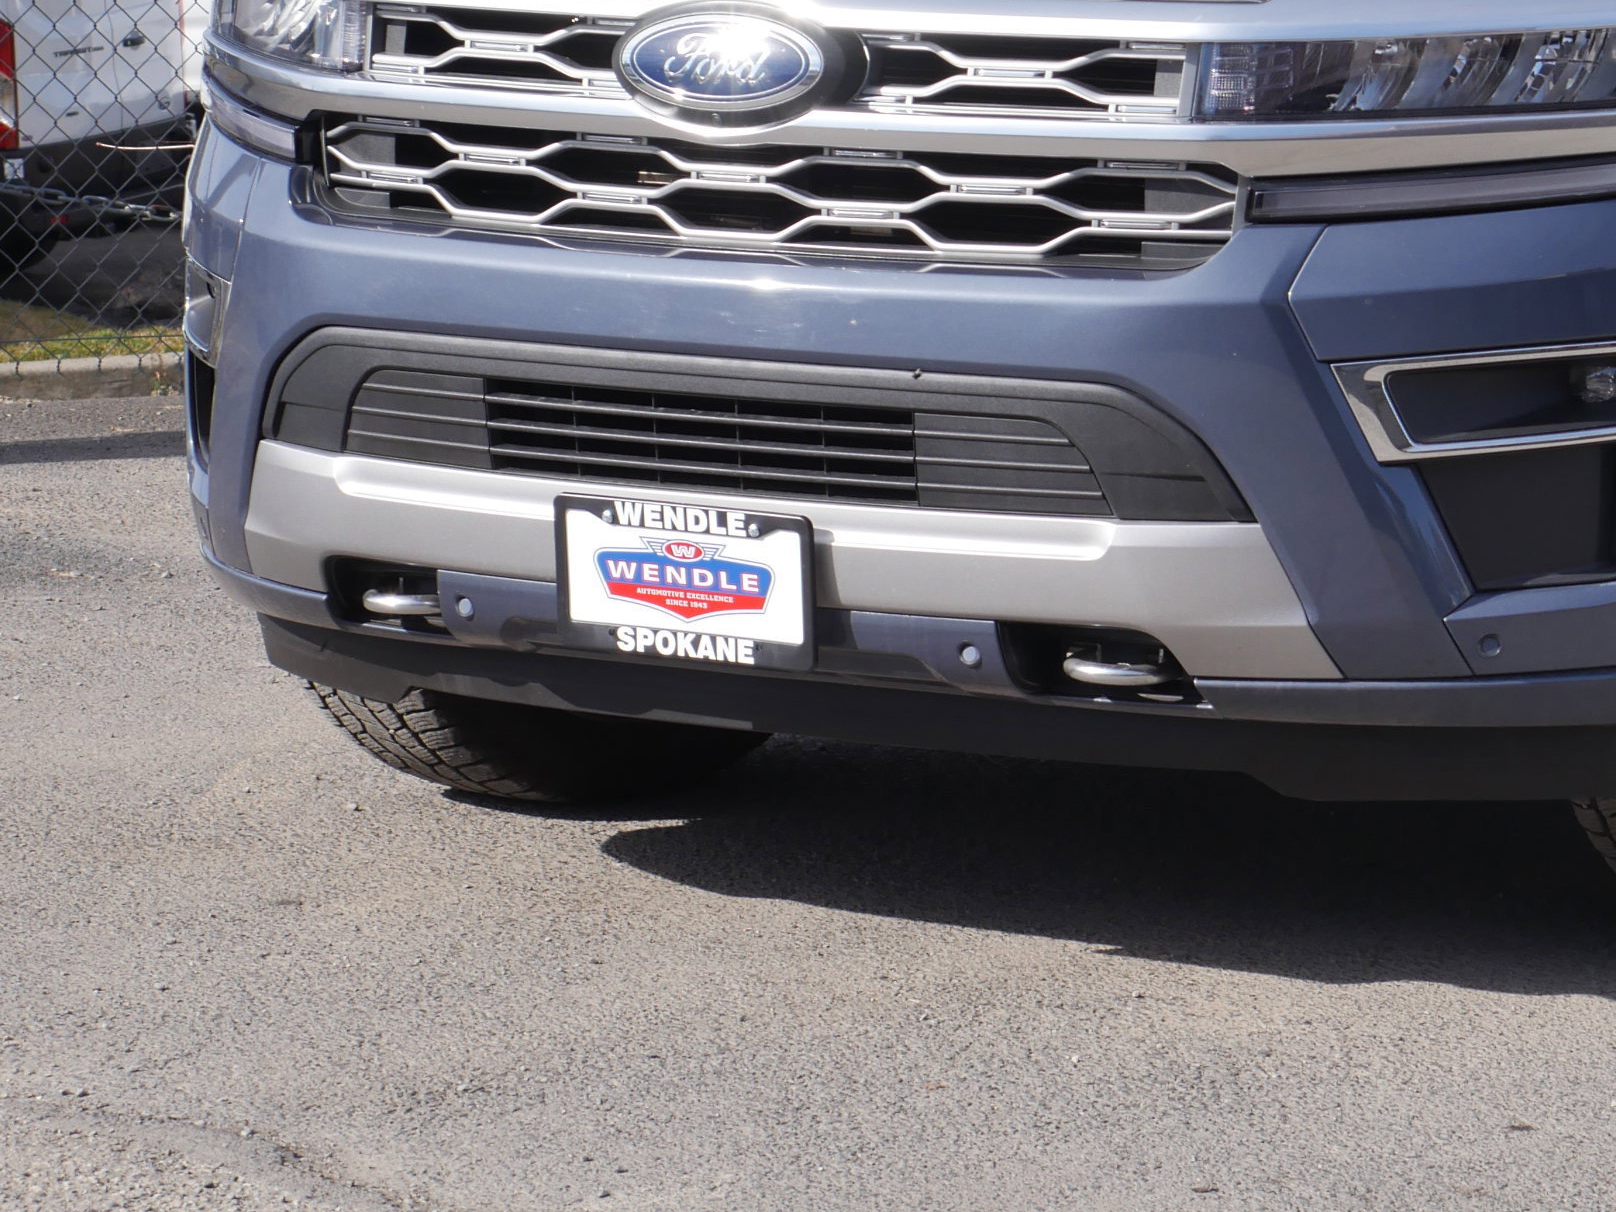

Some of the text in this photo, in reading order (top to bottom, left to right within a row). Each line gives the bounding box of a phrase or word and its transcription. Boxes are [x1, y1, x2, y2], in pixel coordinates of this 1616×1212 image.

[664, 32, 770, 85] Ford
[613, 500, 748, 537] WENDLE
[606, 559, 760, 593] WENDLE
[636, 587, 734, 603] AUTOMOTIVE EXCELLENCE
[665, 598, 708, 609] SINCE 1943
[616, 625, 756, 665] SPOKANE
